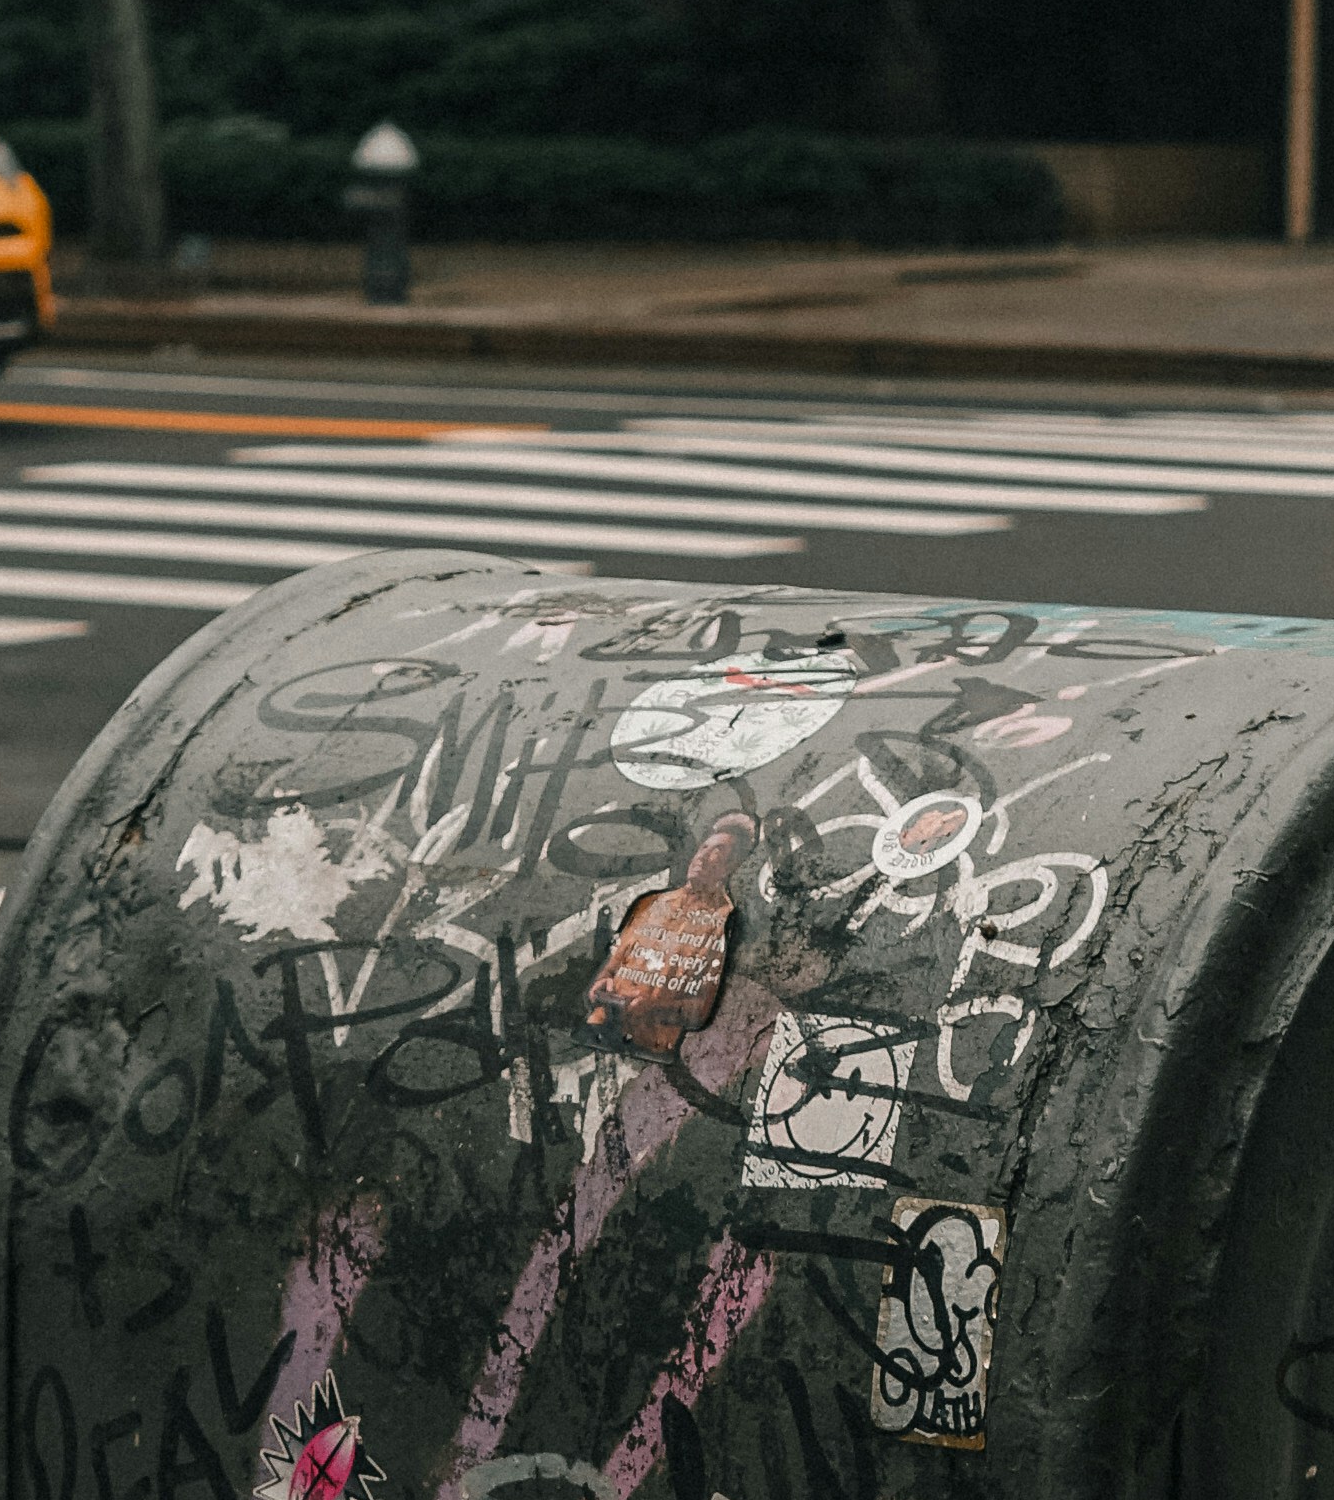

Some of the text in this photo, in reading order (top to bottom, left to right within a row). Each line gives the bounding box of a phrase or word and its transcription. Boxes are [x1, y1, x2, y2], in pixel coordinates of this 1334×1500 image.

[668, 953, 708, 974] every
[616, 965, 702, 996] minute of it!
